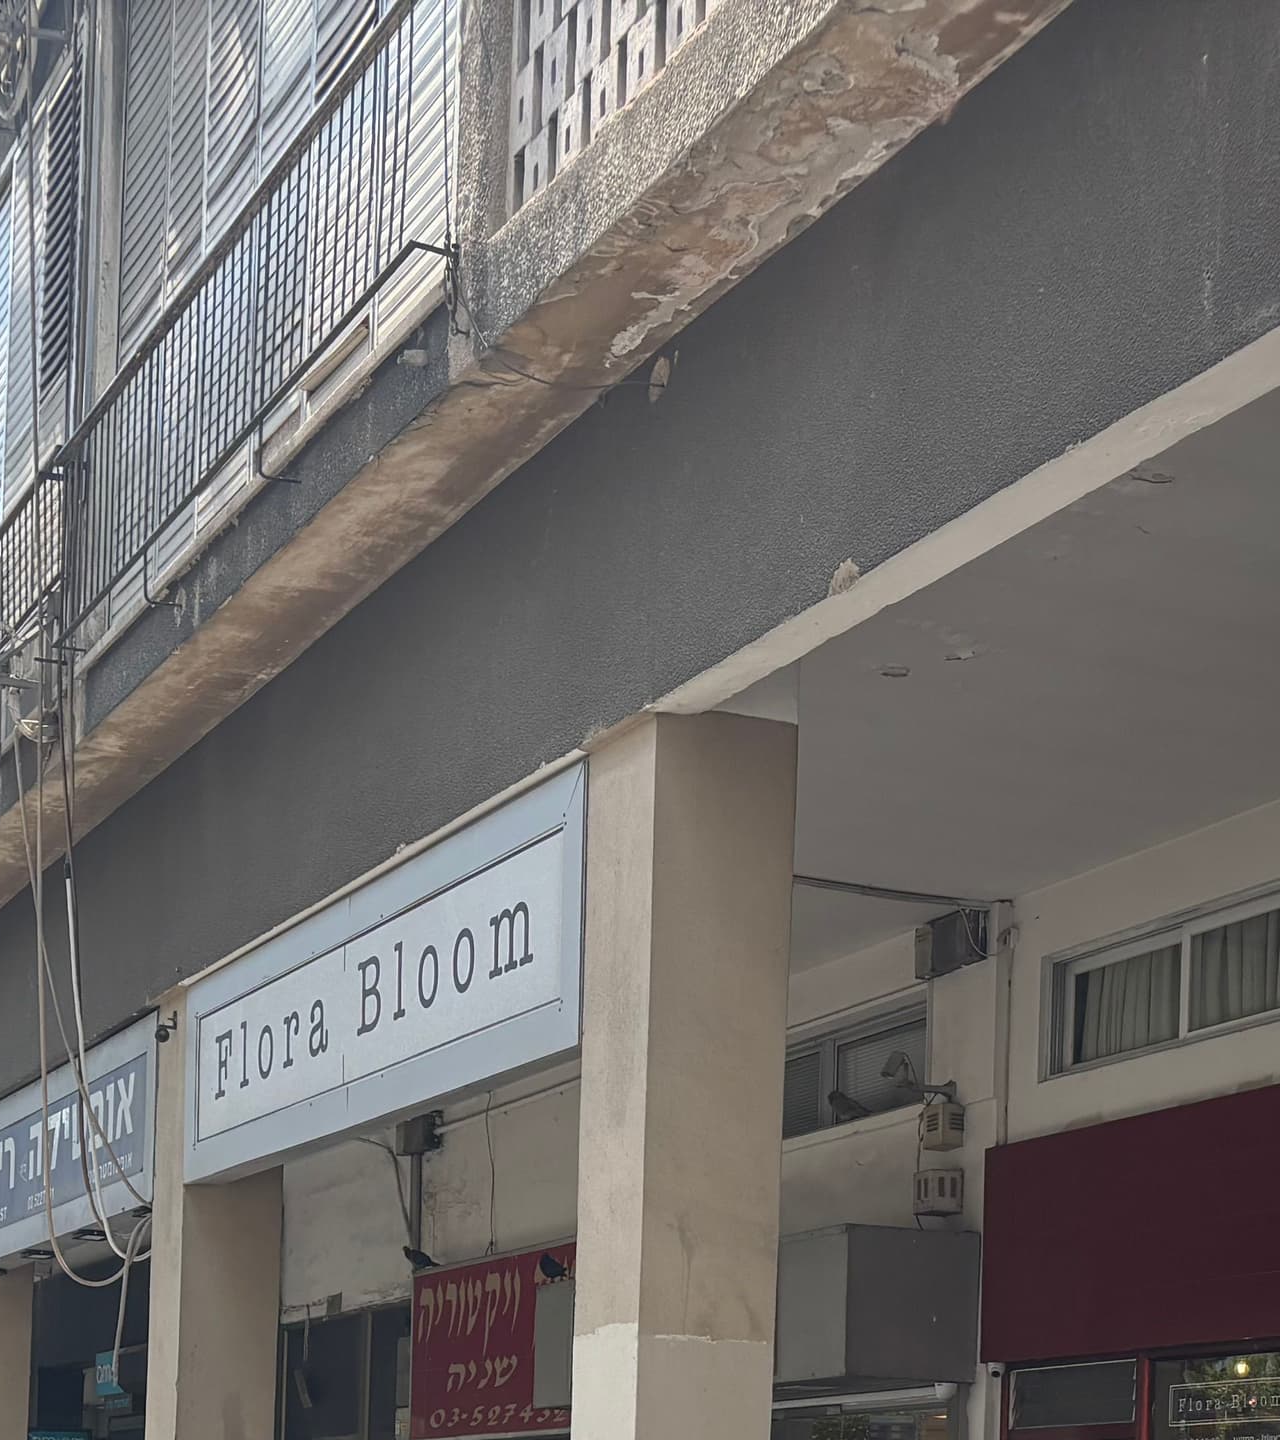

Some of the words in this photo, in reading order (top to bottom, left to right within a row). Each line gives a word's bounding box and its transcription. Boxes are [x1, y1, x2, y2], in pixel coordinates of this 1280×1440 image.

[214, 999, 329, 1101] Flora
[356, 901, 534, 1037] Bloom
[417, 1265, 520, 1356] ויקטוריה
[446, 1354, 518, 1393] שניה
[1178, 1397, 1221, 1413] Flora
